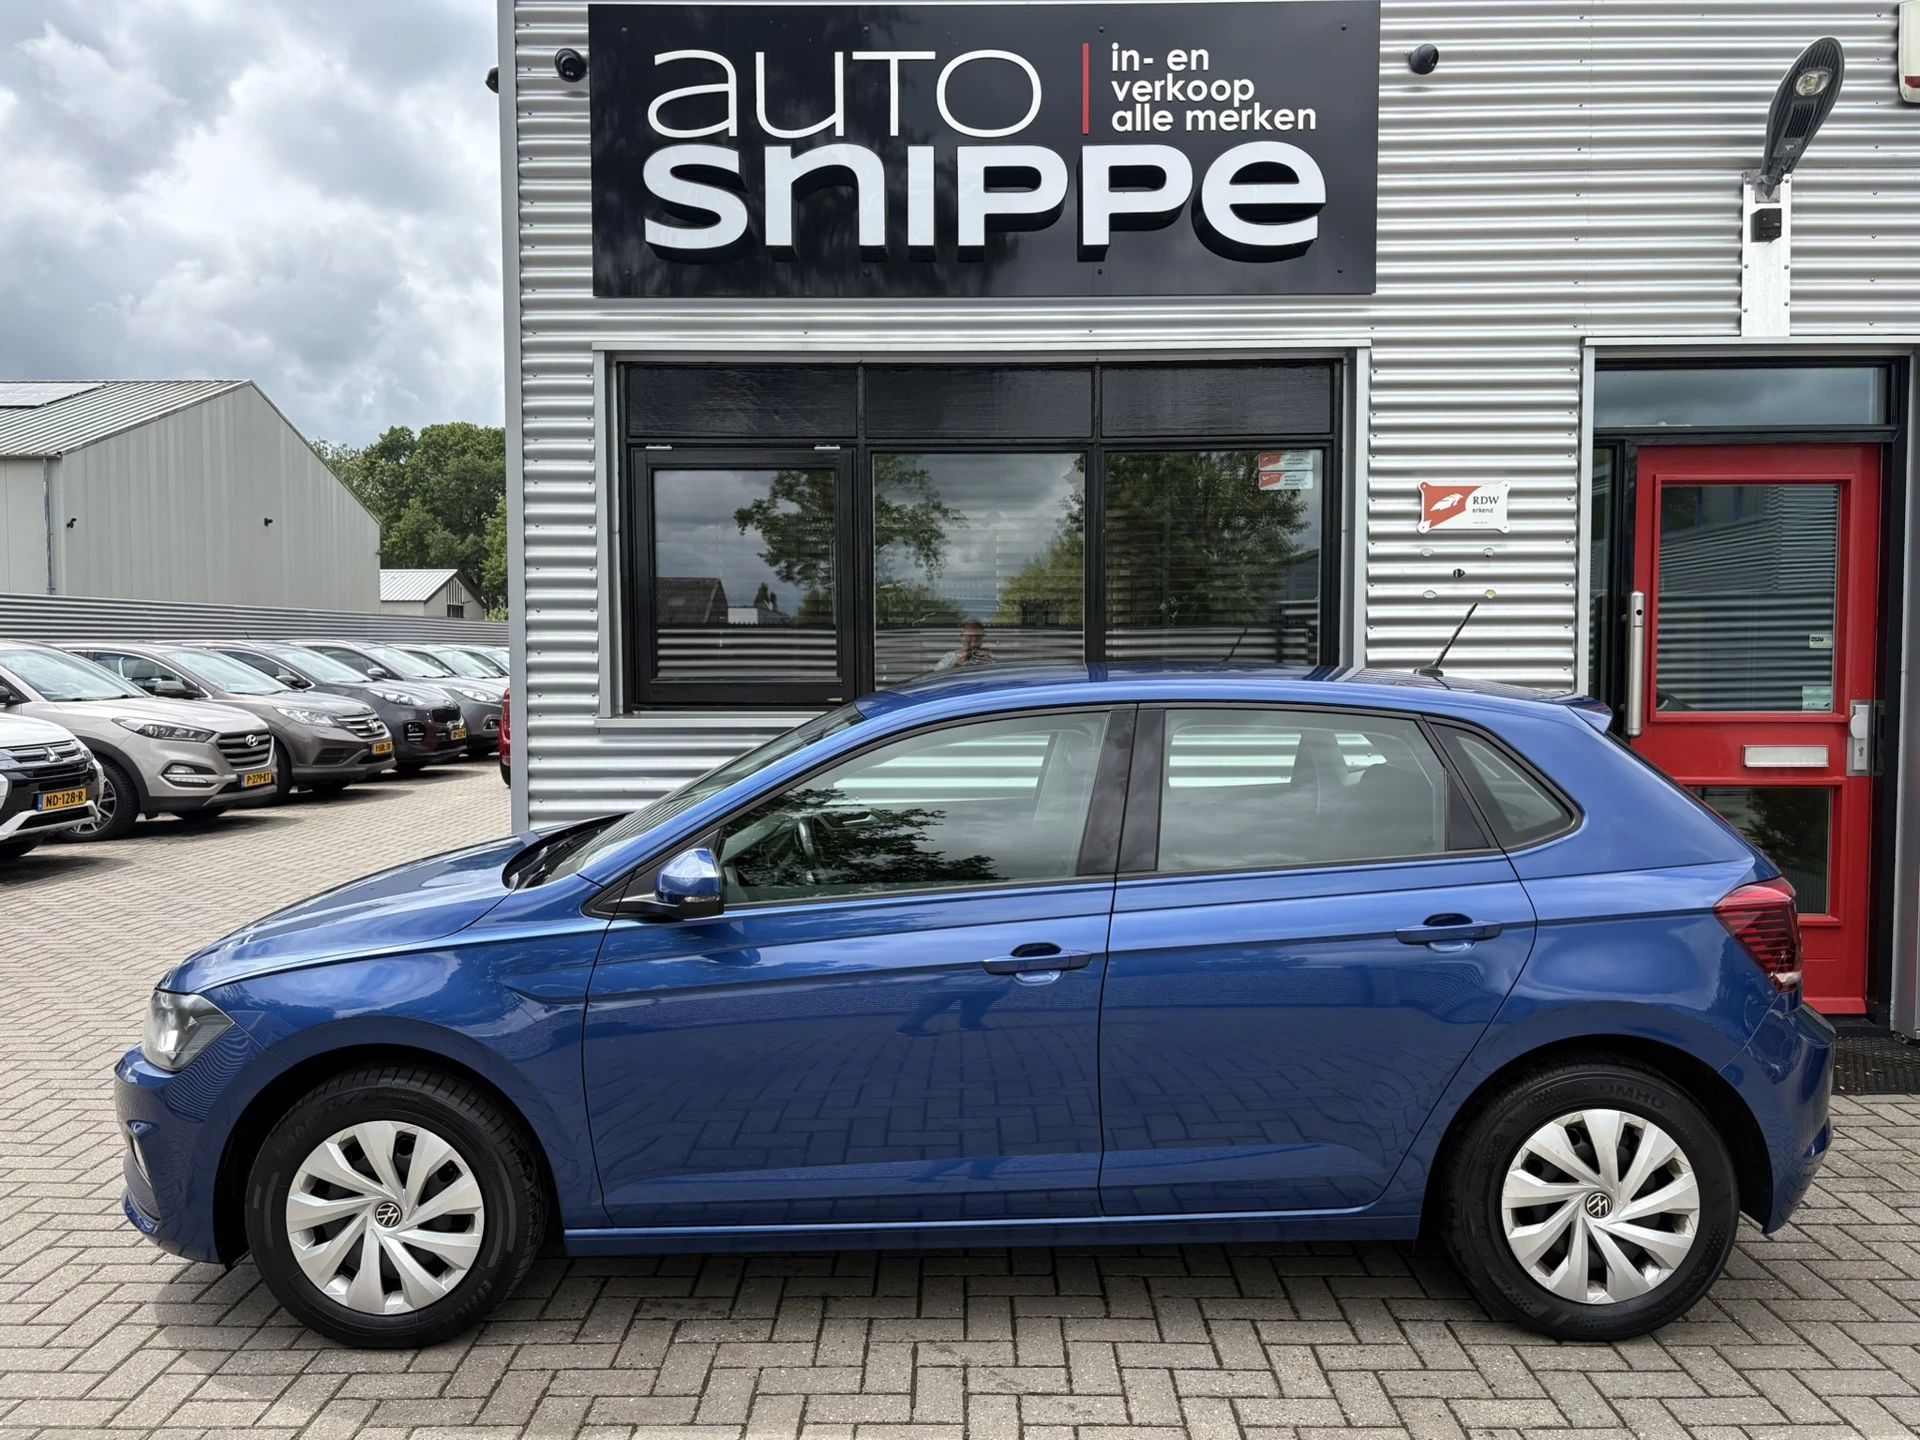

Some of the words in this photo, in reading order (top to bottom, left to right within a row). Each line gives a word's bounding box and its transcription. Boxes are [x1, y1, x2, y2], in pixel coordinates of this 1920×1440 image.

[1111, 42, 1154, 72] in-
[1166, 48, 1210, 72] en
[1111, 72, 1255, 108] verkoop
[1111, 102, 1174, 132] alle
[1185, 101, 1317, 132] merken
[1472, 495, 1500, 505] RDW
[46, 791, 84, 807] ND-128-R
